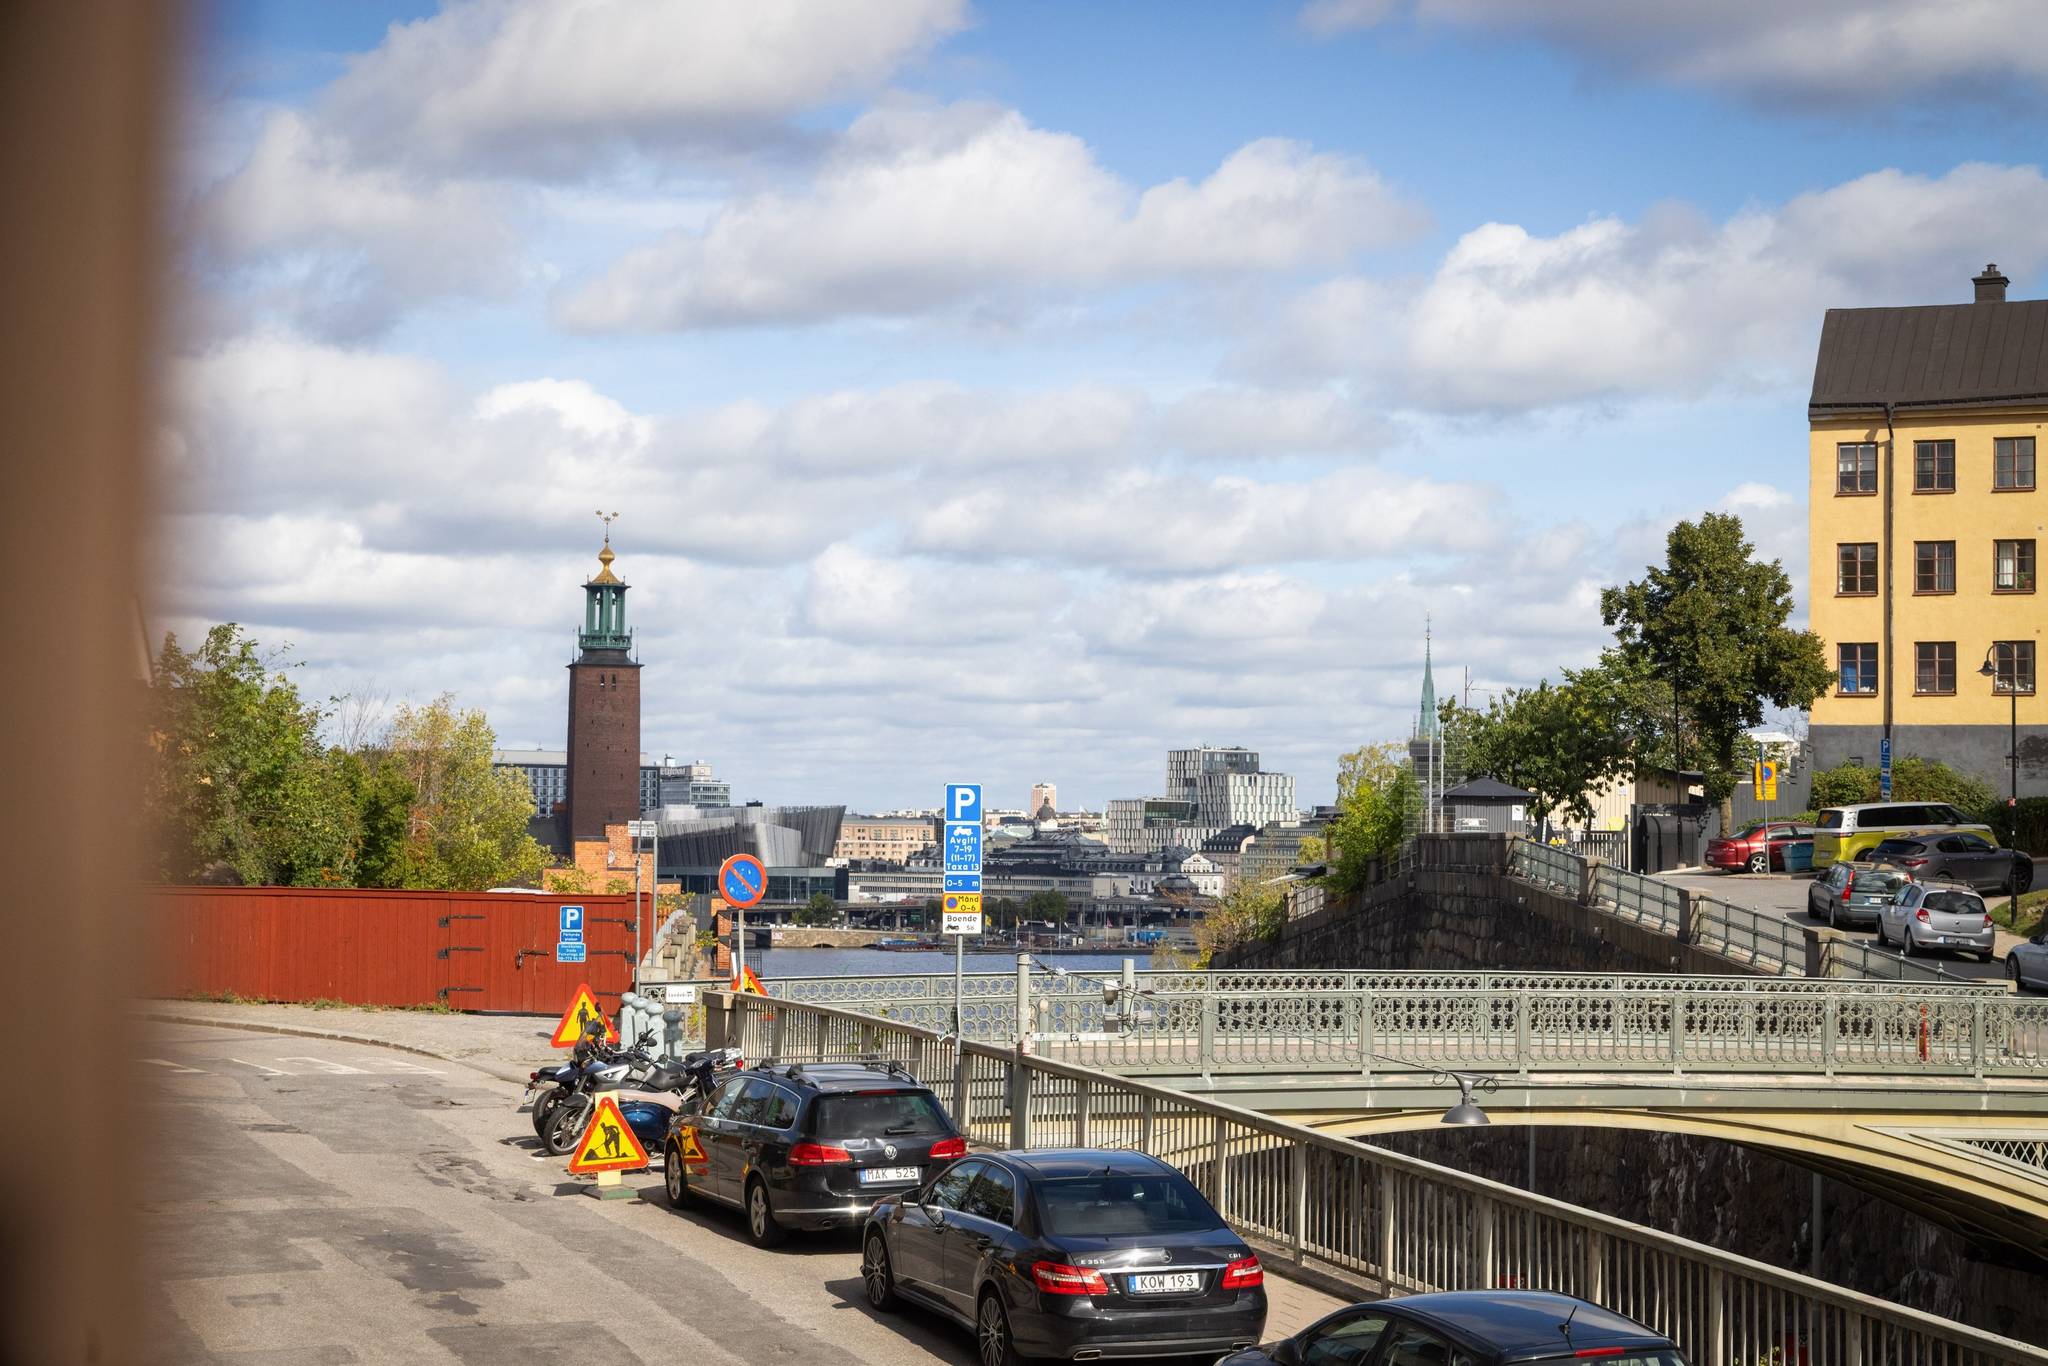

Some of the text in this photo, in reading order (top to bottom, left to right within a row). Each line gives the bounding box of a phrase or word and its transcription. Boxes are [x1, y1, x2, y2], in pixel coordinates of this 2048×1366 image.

[1883, 741, 1889, 752] P
[954, 787, 976, 819] P
[950, 836, 977, 845] Avgift
[954, 845, 973, 853] 7-19
[951, 853, 976, 862] (11-17)
[946, 879, 963, 887] 0-5
[566, 908, 579, 929] P
[867, 1167, 916, 1180] MAK 525
[1140, 1274, 1194, 1288] KOW 193
